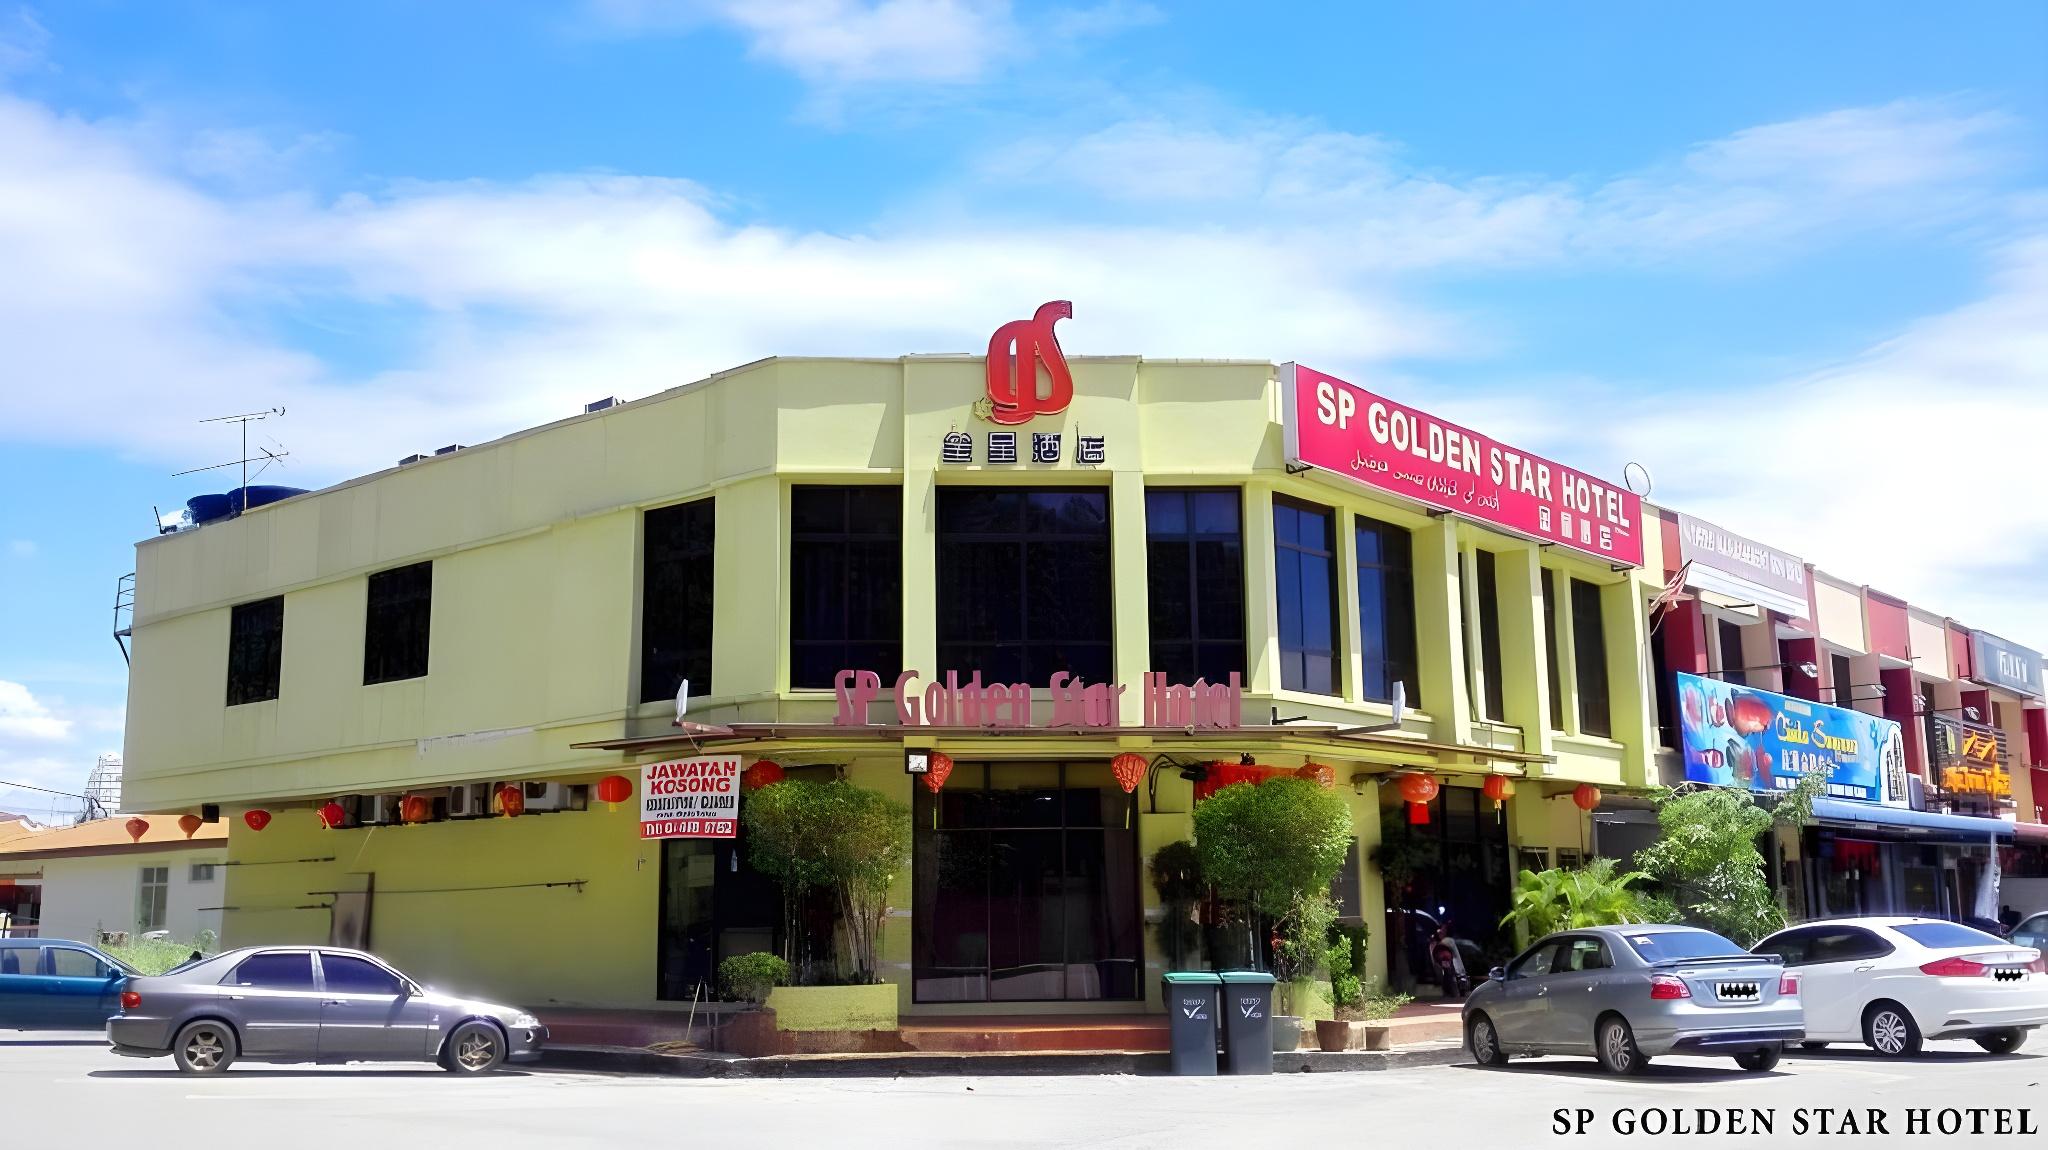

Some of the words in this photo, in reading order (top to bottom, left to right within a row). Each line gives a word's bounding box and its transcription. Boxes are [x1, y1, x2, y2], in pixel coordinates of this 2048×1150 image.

[1316, 382, 1356, 430] SP
[1368, 403, 1481, 477] GOLDEN
[1490, 447, 1552, 502] STAR
[1561, 472, 1630, 528] HOTEL
[834, 669, 881, 725] SP
[894, 669, 1031, 727] Golden
[1049, 670, 1126, 728] Star
[1143, 671, 1241, 728] Hotel
[647, 761, 736, 780] JAWATAN
[651, 777, 731, 795] KOSONG
